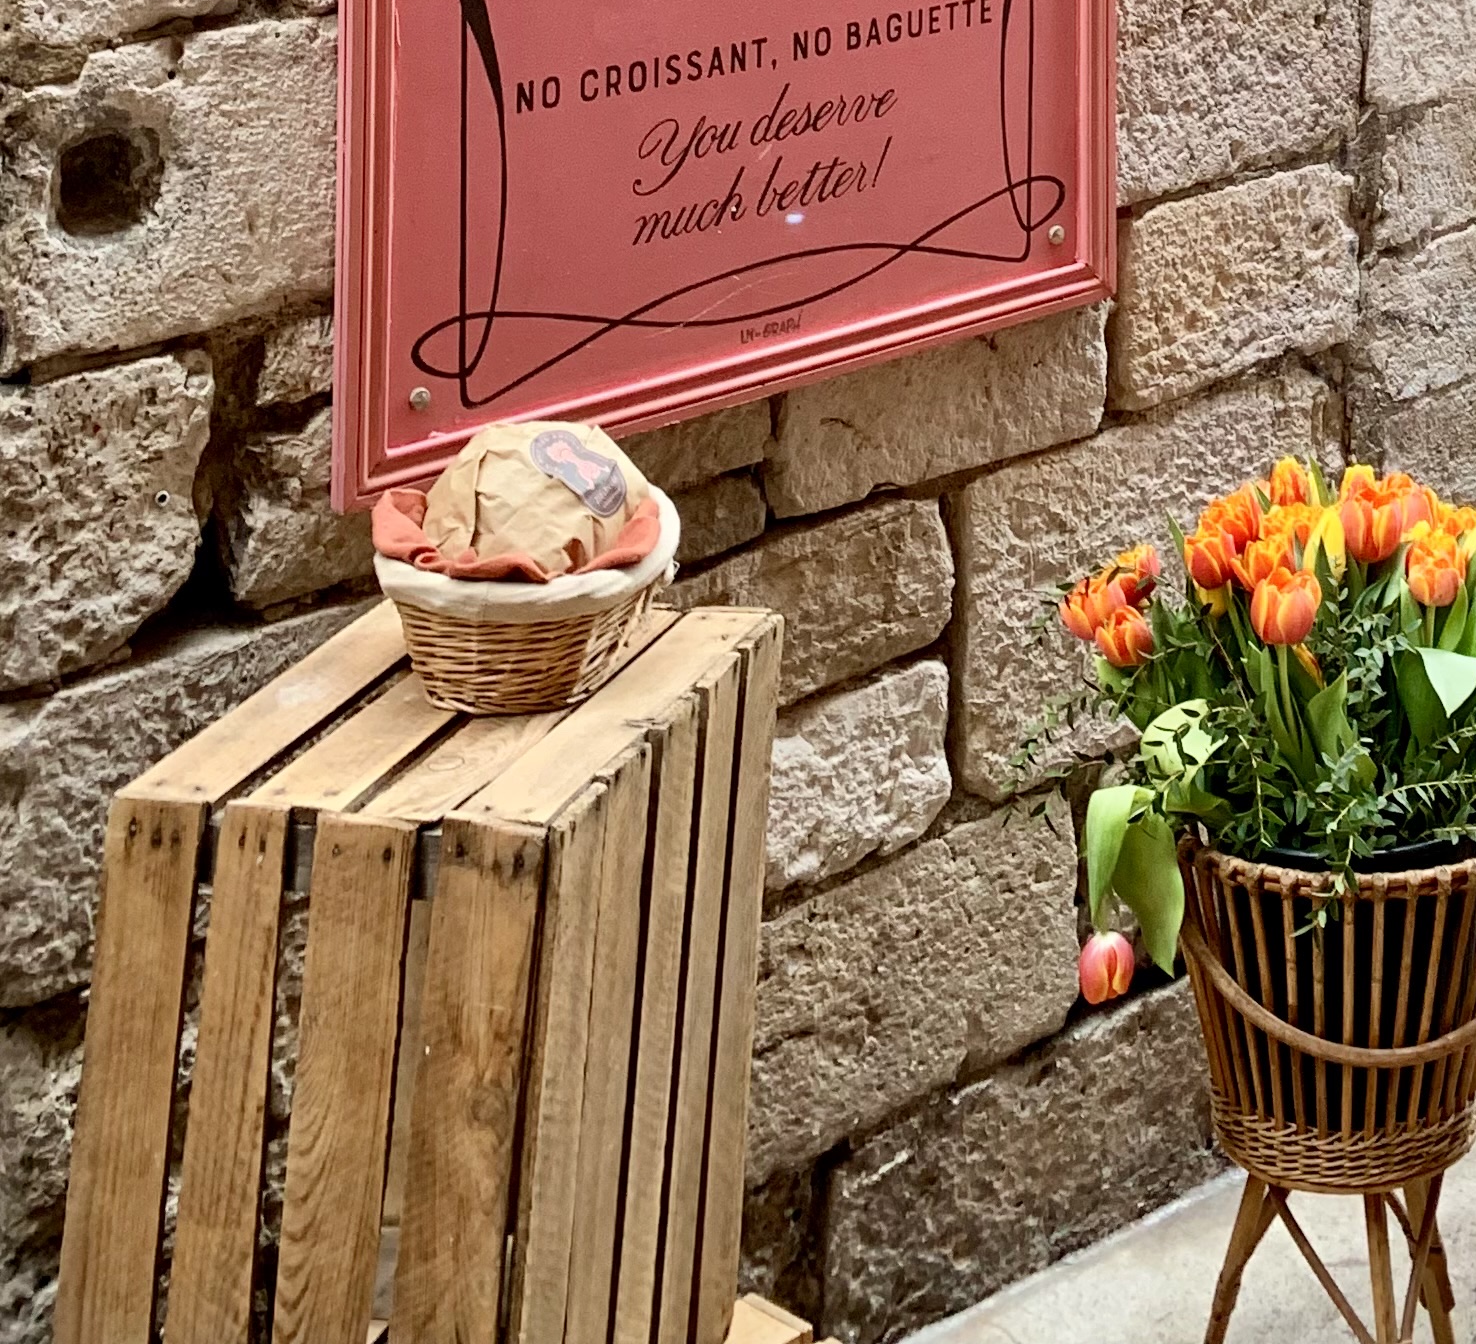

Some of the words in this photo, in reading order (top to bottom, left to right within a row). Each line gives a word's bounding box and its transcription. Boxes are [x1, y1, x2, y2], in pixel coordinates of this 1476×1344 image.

[516, 77, 562, 116] NO
[580, 37, 779, 103] CROISSANT,
[793, 26, 833, 63] NO
[632, 116, 741, 196] You
[749, 82, 899, 149] deserve
[632, 164, 747, 246] much
[755, 134, 895, 218] better!
